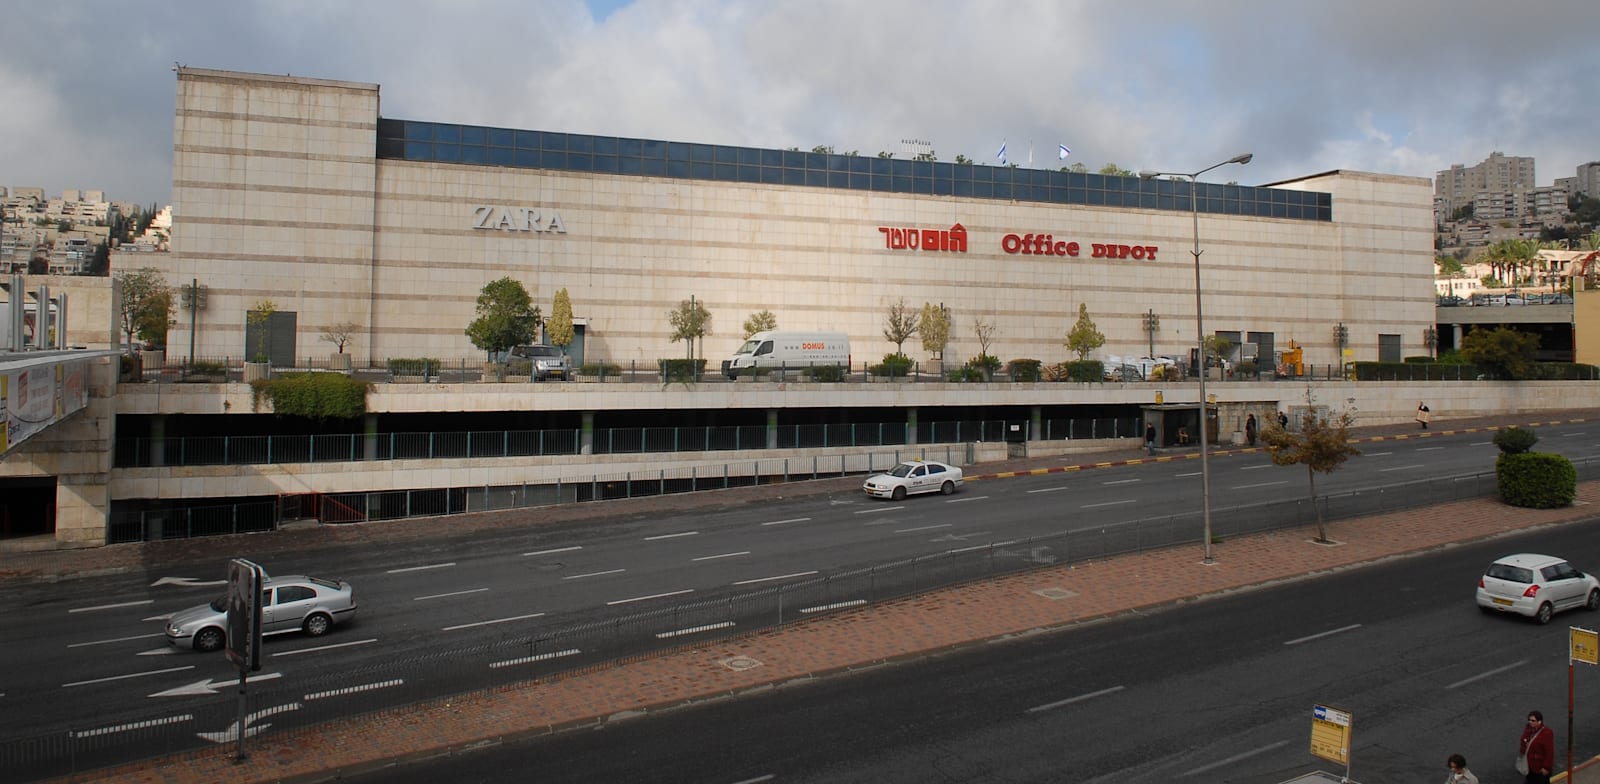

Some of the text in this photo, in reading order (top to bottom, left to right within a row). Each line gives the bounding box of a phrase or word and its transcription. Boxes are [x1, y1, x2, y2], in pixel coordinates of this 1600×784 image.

[472, 206, 567, 233] ZARA
[879, 223, 968, 252] הום סנטר
[1001, 233, 1159, 260] Office DEPOT
